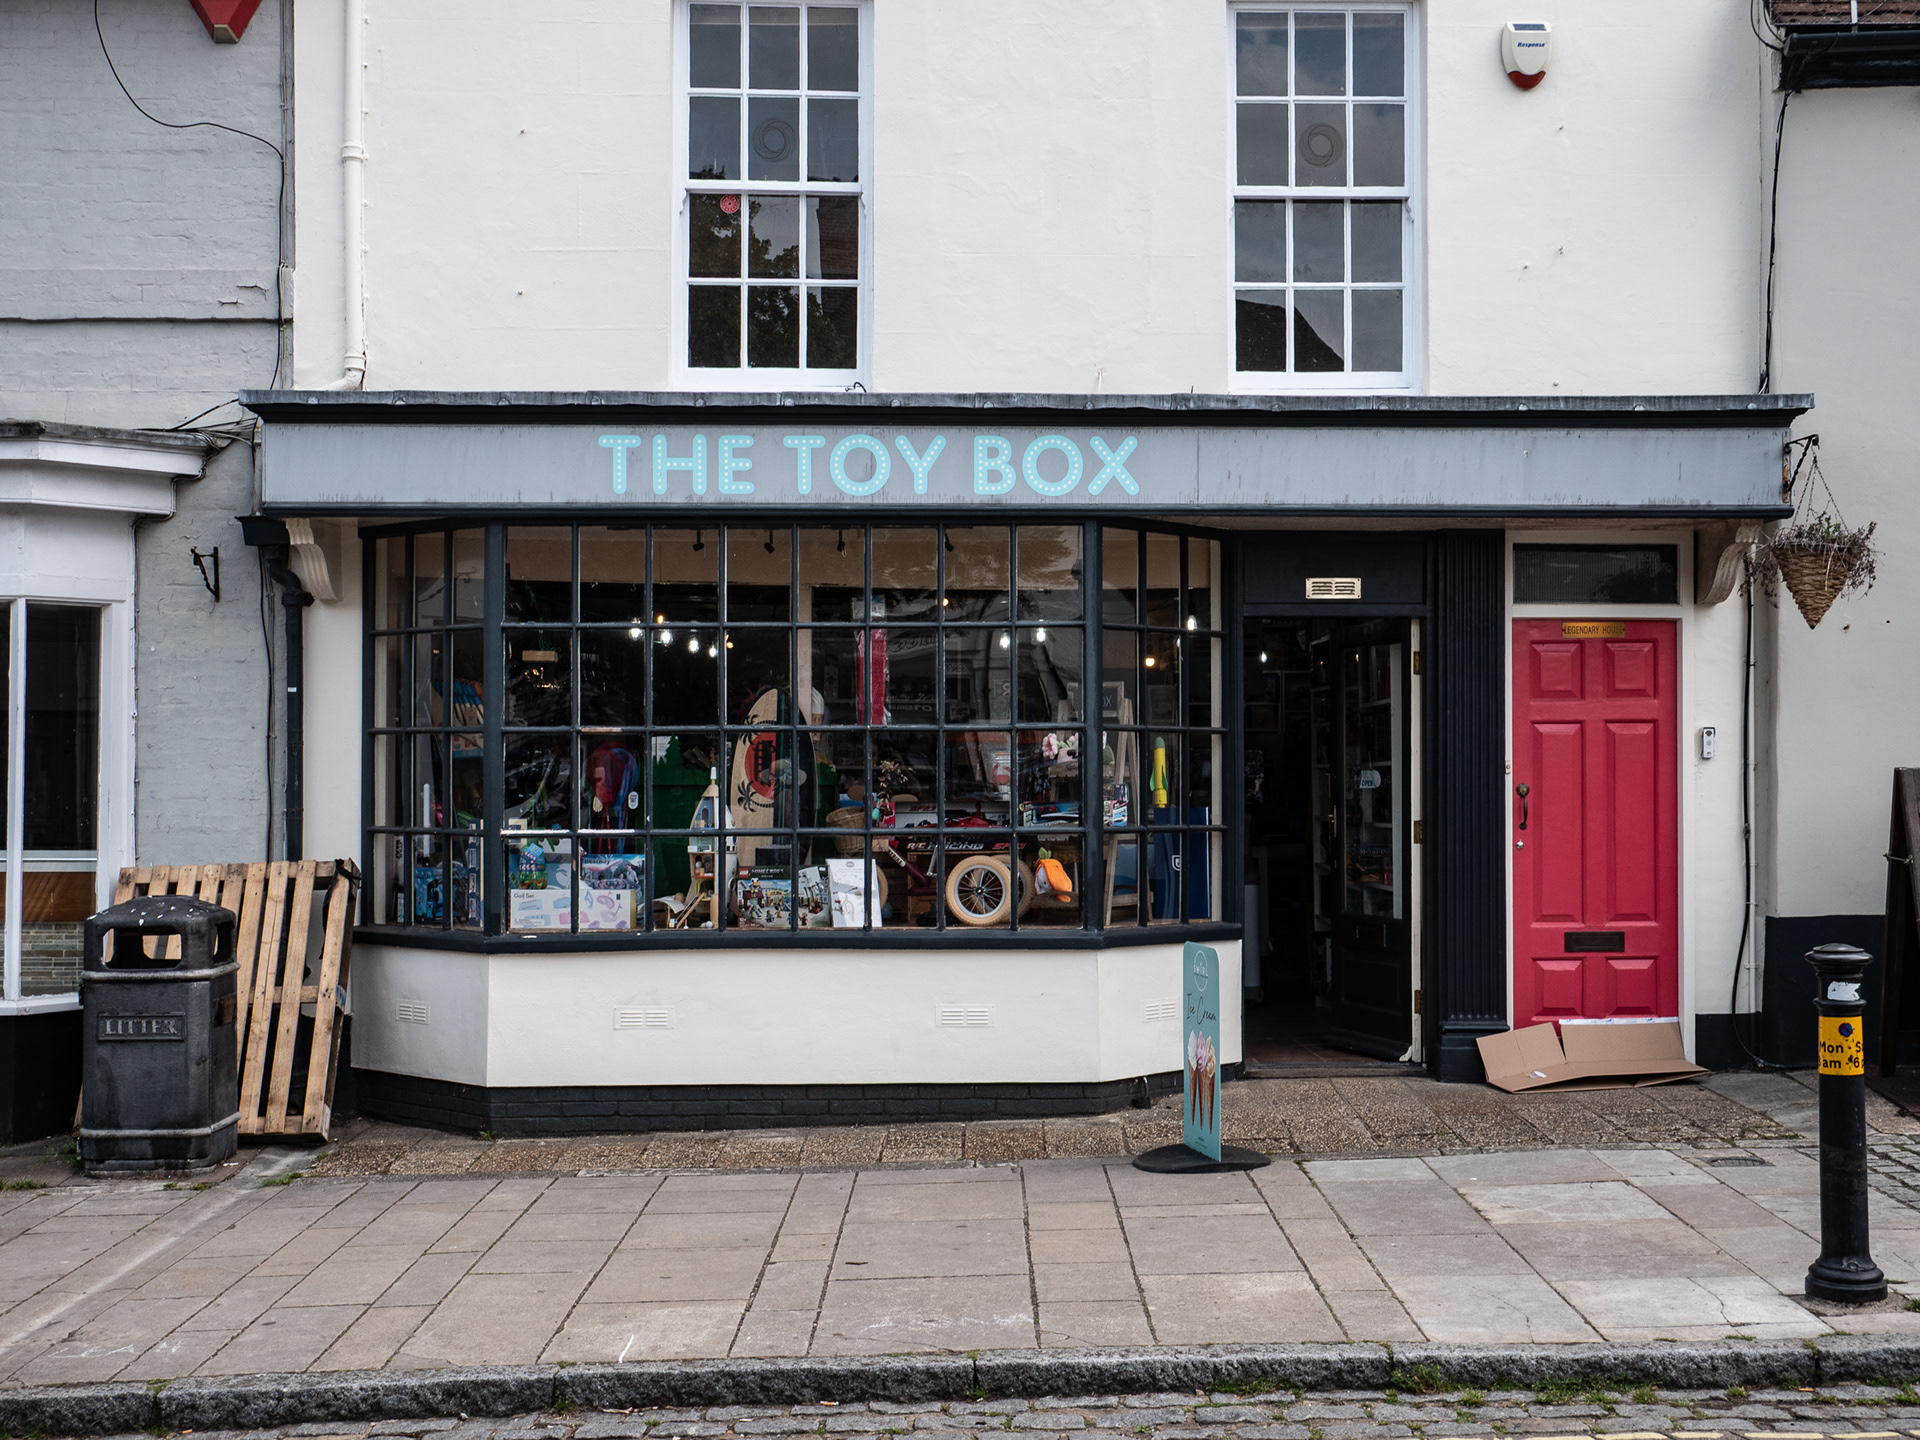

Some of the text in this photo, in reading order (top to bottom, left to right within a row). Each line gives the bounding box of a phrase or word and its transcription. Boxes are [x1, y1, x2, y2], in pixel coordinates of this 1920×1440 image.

[598, 434, 1140, 496] THE TOY BOX
[1564, 625, 1624, 634] LEGENDARY HOUSE
[907, 842, 927, 850] R/C
[104, 1018, 178, 1035] LITTER
[1820, 1041, 1844, 1053] Mon
[1856, 1041, 1863, 1053] S
